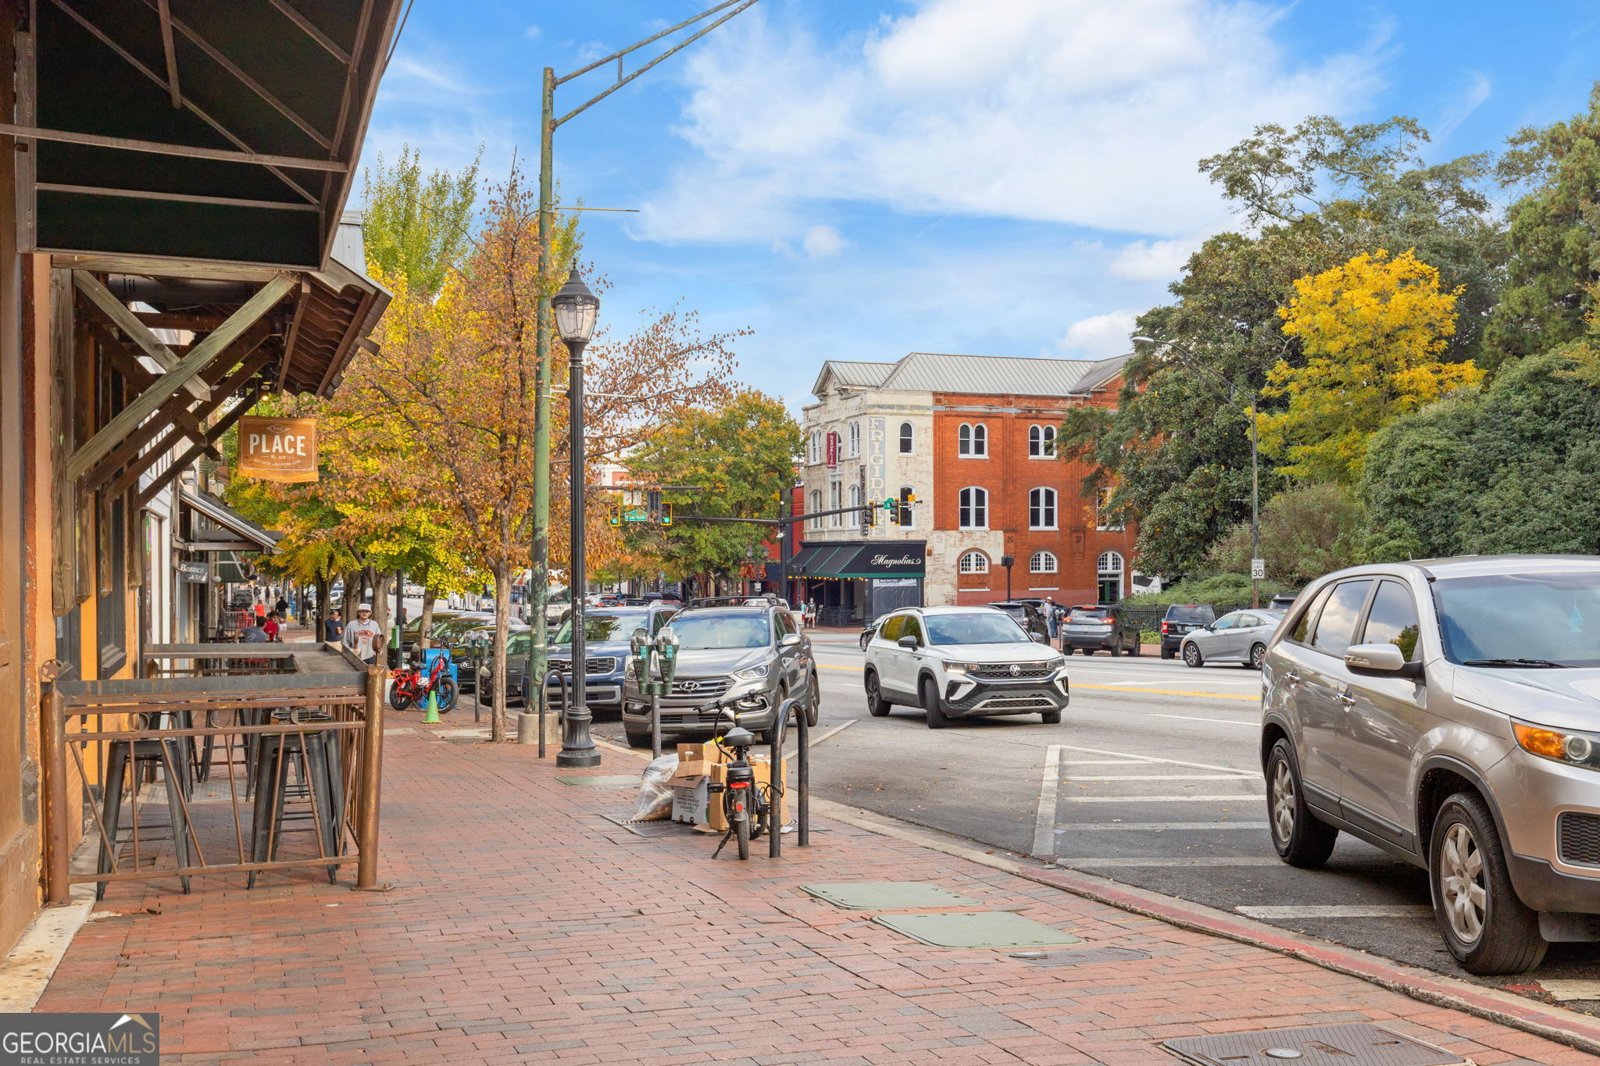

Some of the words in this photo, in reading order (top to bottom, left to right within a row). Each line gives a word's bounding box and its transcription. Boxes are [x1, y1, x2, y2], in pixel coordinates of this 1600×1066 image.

[249, 433, 306, 456] PLACE
[870, 554, 921, 568] Magnolias
[1253, 569, 1264, 577] 30
